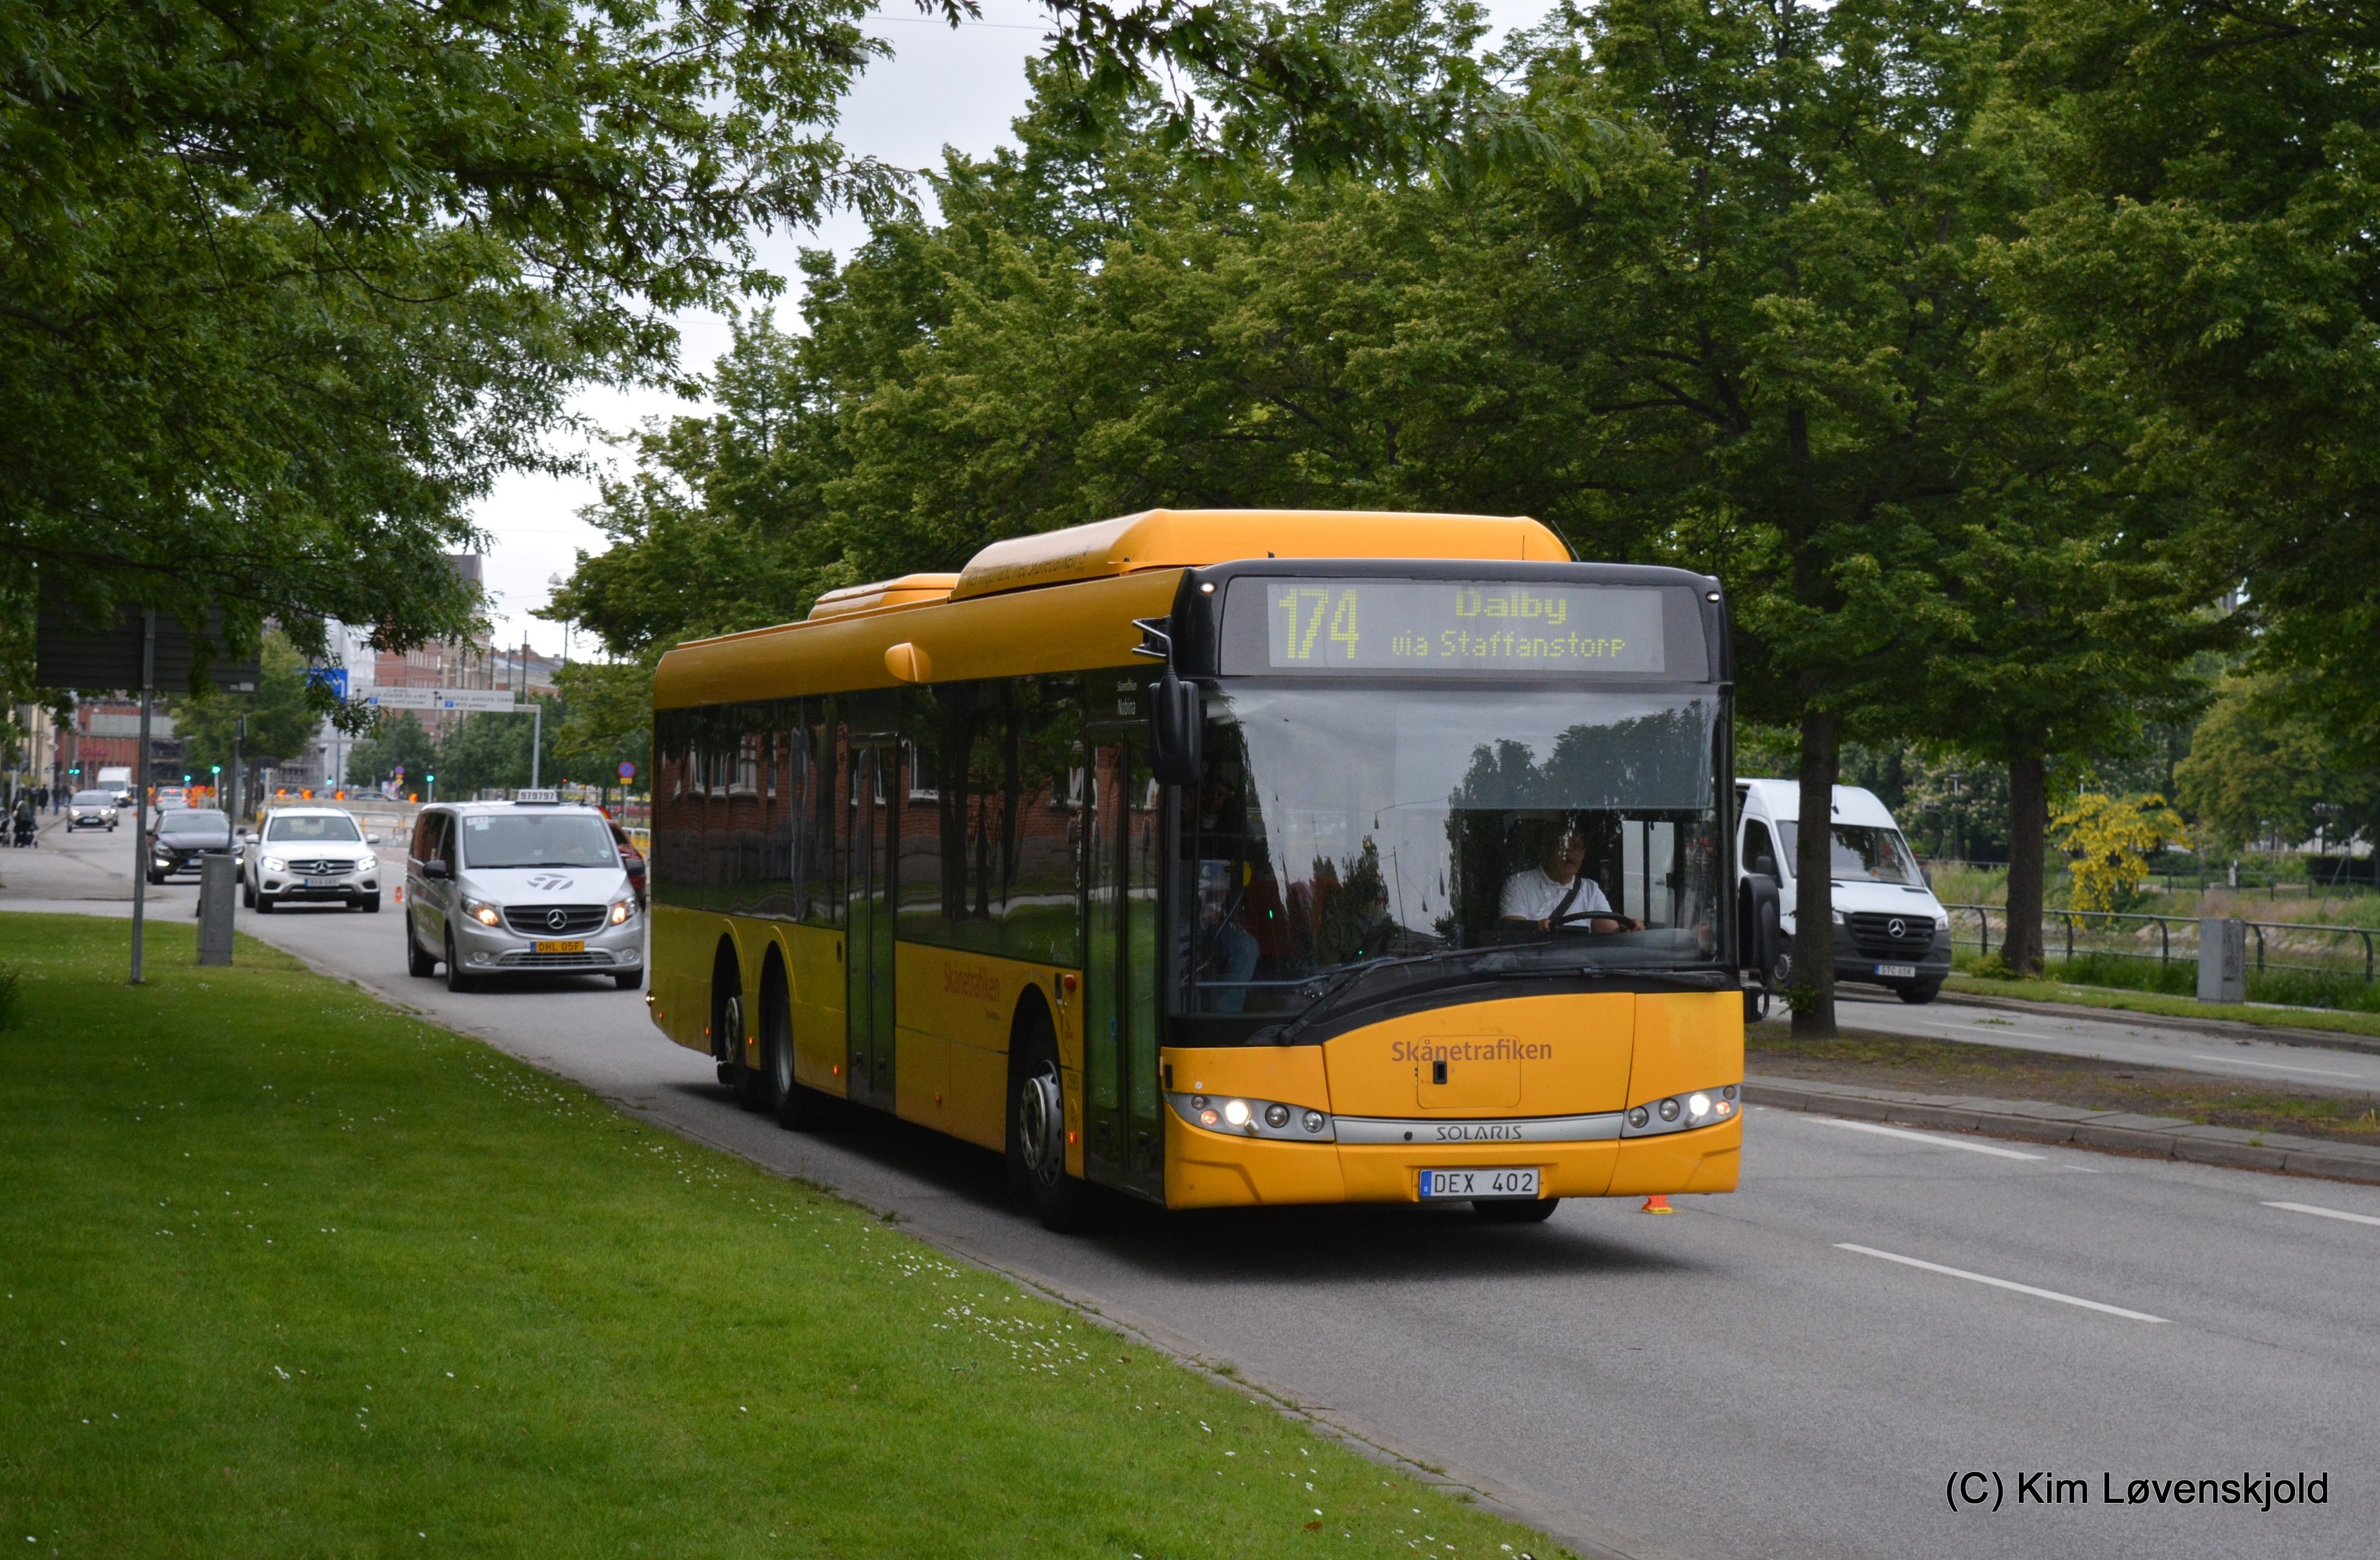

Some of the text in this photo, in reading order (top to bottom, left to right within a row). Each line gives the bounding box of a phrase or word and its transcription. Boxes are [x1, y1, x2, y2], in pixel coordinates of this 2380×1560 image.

[1455, 590, 1566, 625] Dalby
[1279, 588, 1359, 659] 174
[1392, 629, 1626, 658] via Staffanstorp
[1117, 697, 1135, 716] Nobina
[521, 791, 554, 800] 979797
[539, 942, 557, 951] DHL
[944, 959, 1000, 1002] Skånetrafiken
[1391, 1038, 1553, 1062] Skånetrafiken
[1436, 1125, 1522, 1141] SOLARIS
[1434, 1173, 1474, 1193] DEX
[1492, 1172, 1533, 1192] 402
